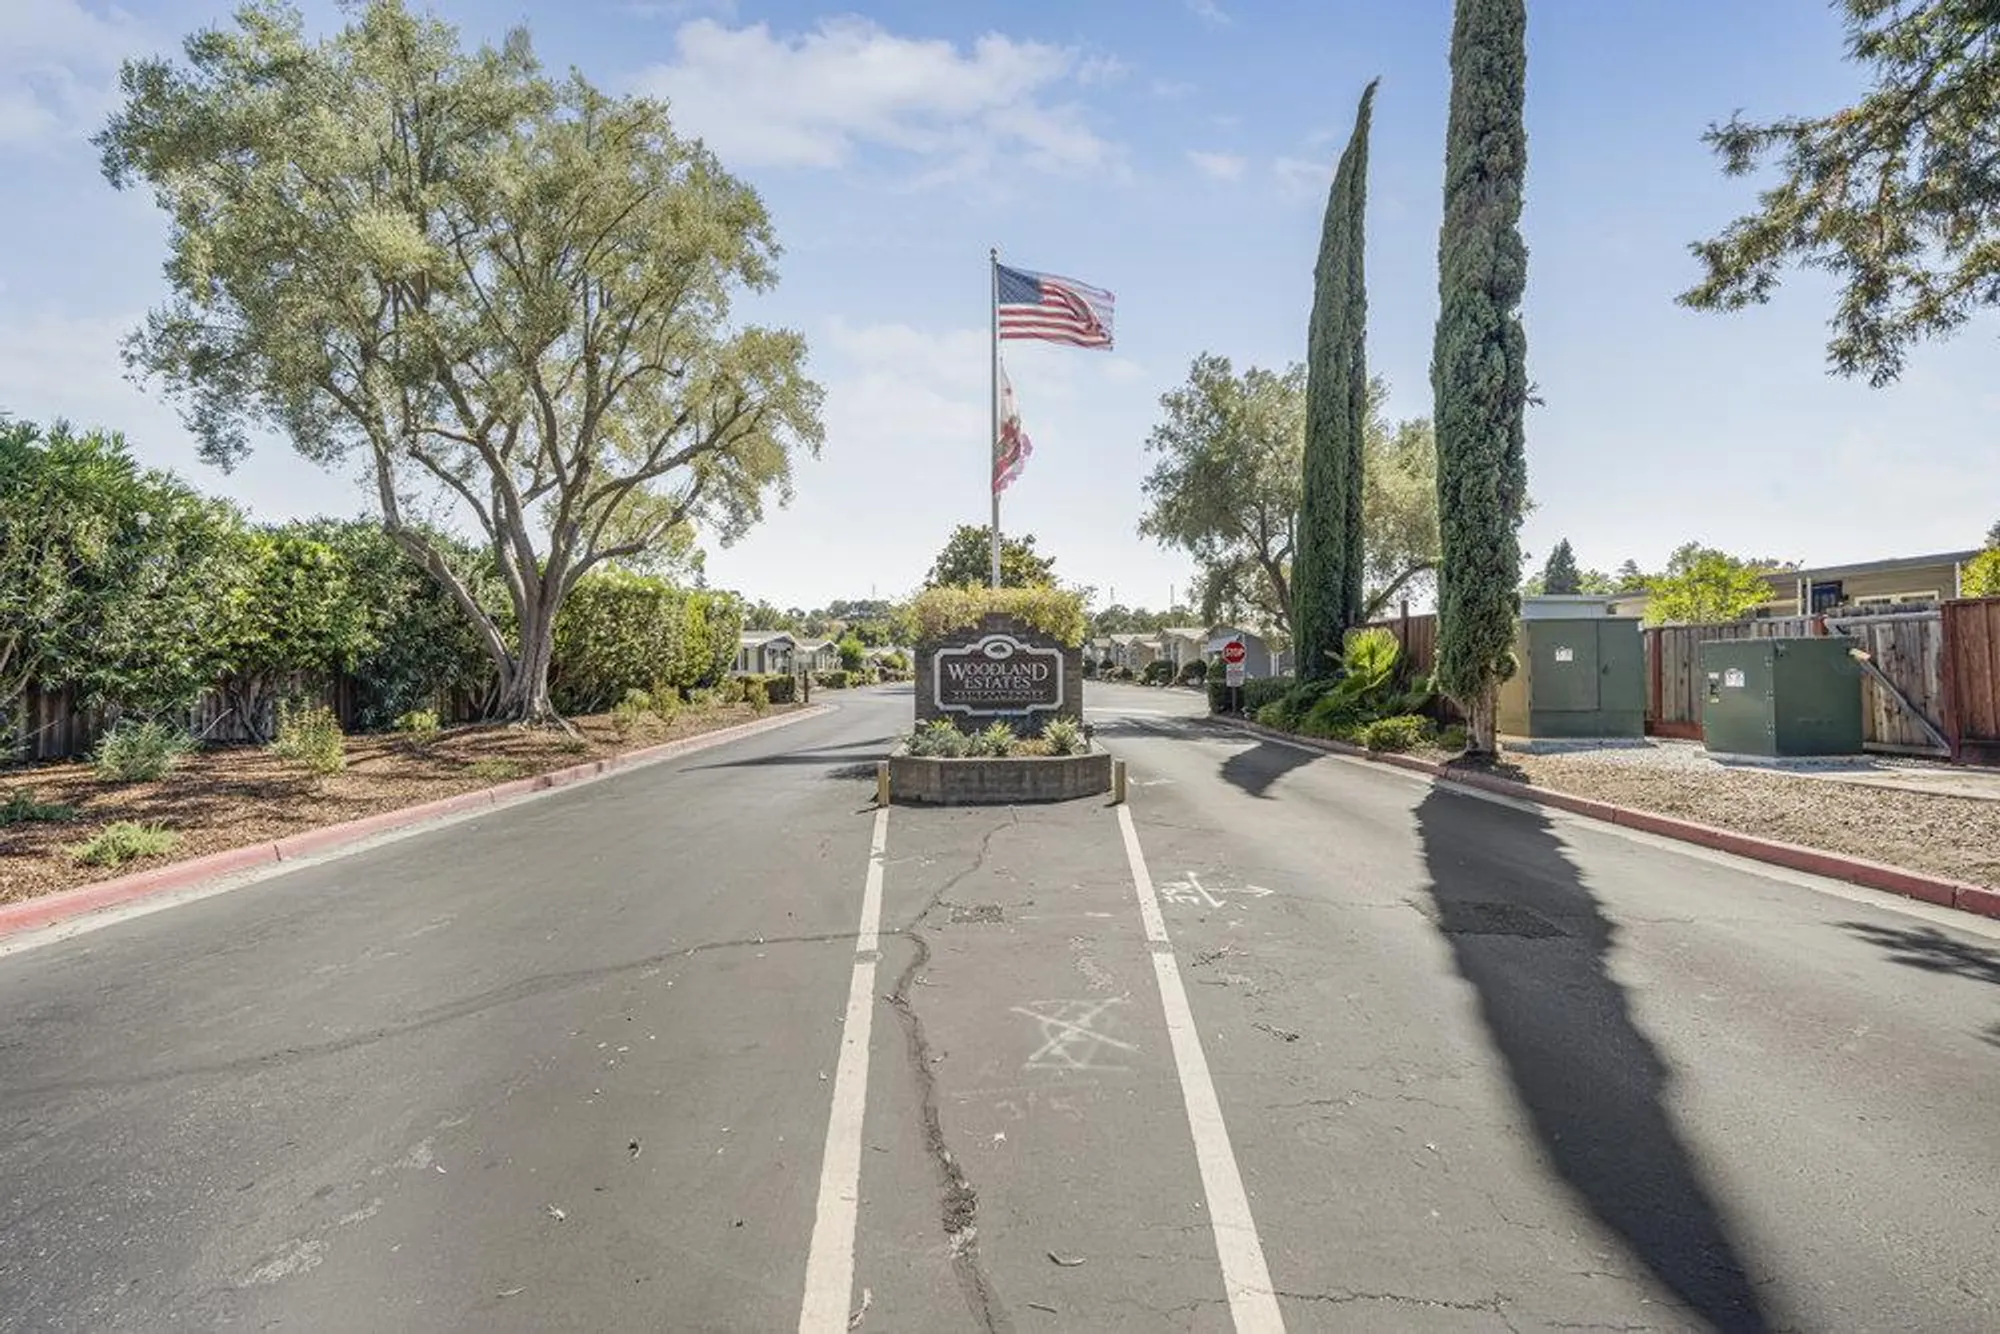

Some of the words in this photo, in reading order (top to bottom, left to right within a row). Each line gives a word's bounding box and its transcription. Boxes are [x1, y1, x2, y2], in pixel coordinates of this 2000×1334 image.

[1225, 647, 1244, 658] STOP
[947, 662, 1048, 681] WOODLAND
[964, 676, 1031, 689] ESTATES
